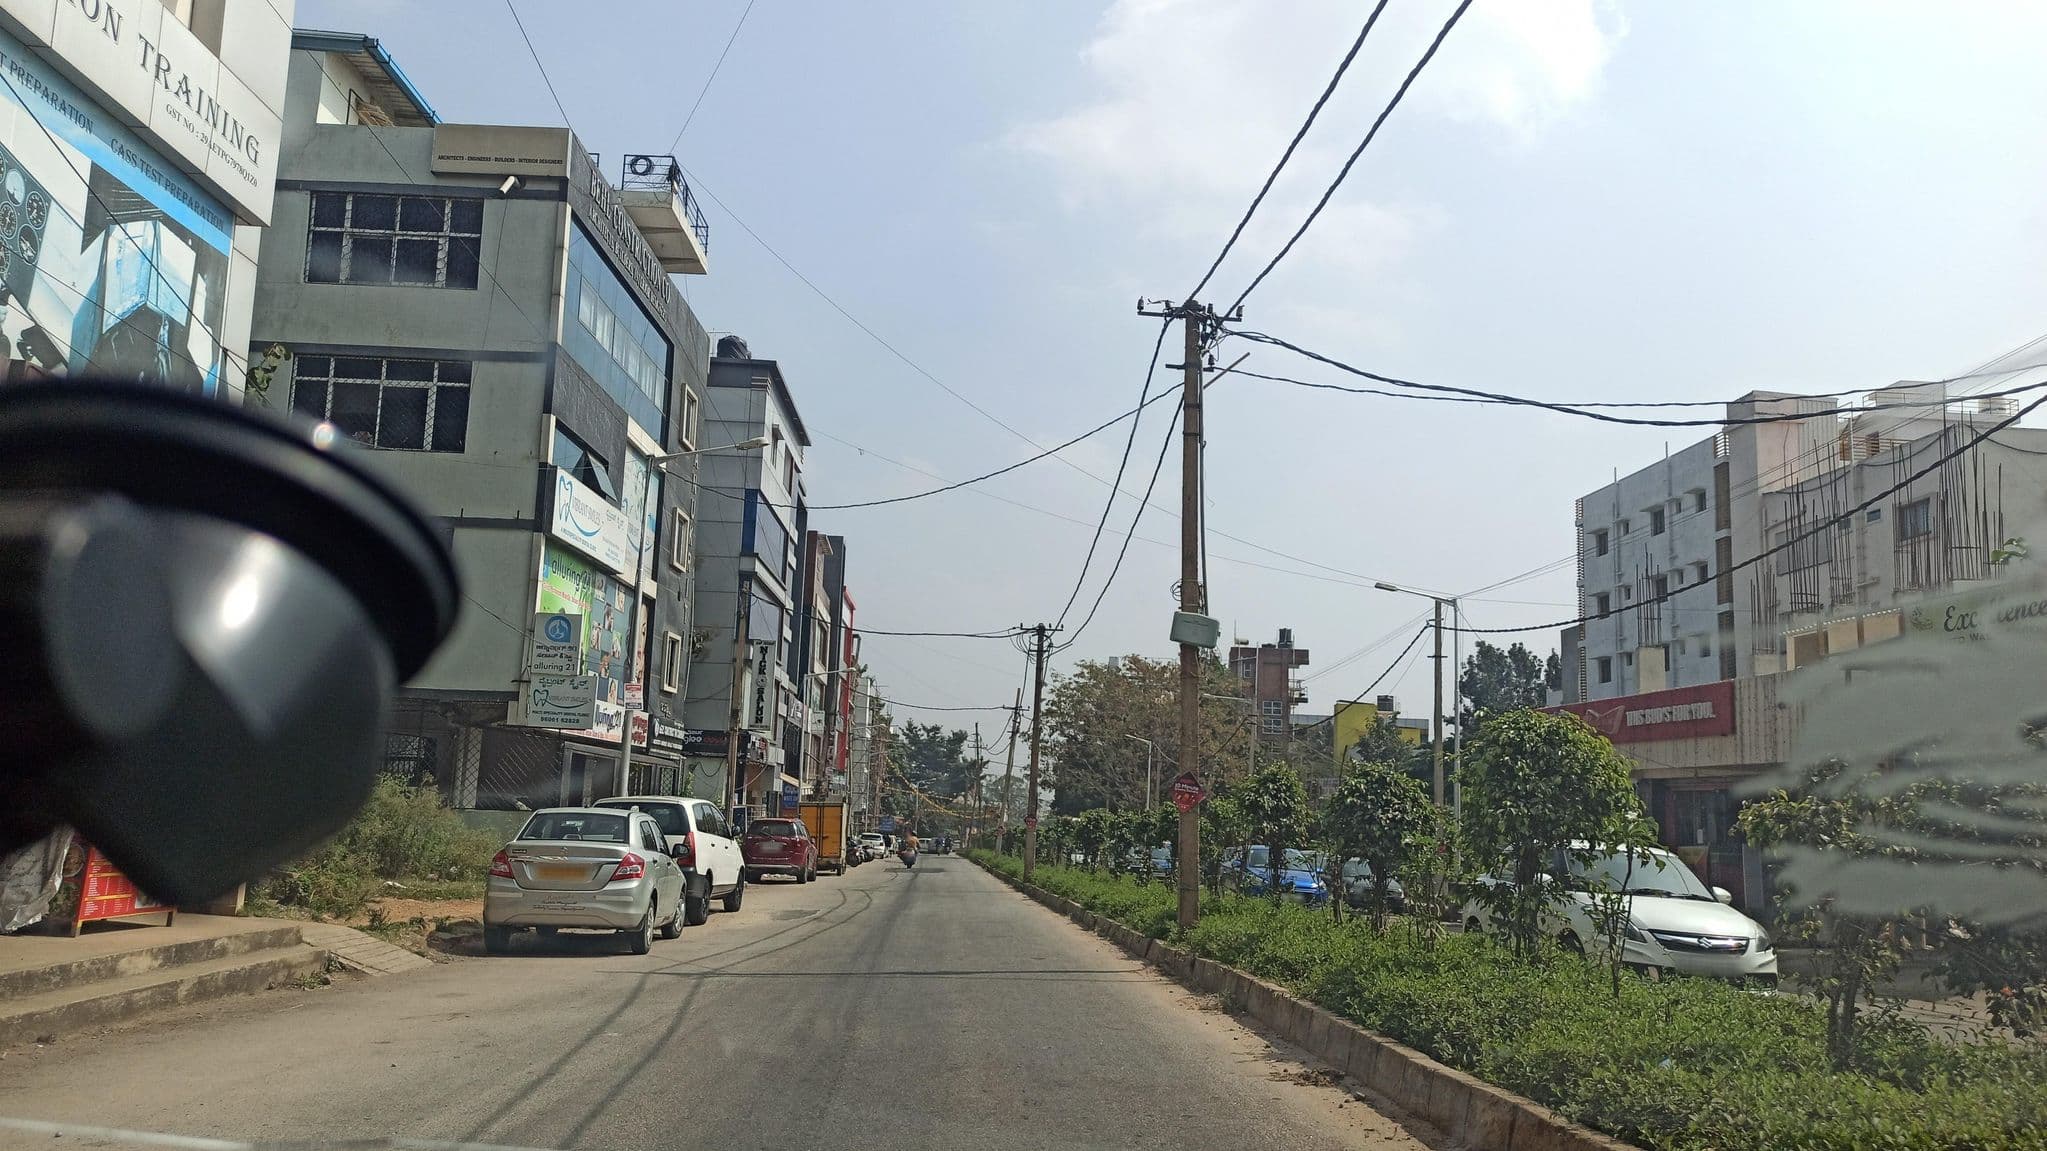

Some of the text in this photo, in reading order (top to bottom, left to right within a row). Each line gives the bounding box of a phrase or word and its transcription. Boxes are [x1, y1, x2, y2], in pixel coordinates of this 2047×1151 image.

[9, 60, 95, 135] PREPARATION
[137, 33, 261, 168] TRAINING
[166, 103, 182, 122] GST
[182, 116, 195, 134] NO
[110, 138, 225, 233] CASS TEST PREPARATION
[533, 661, 575, 672] alluring 21
